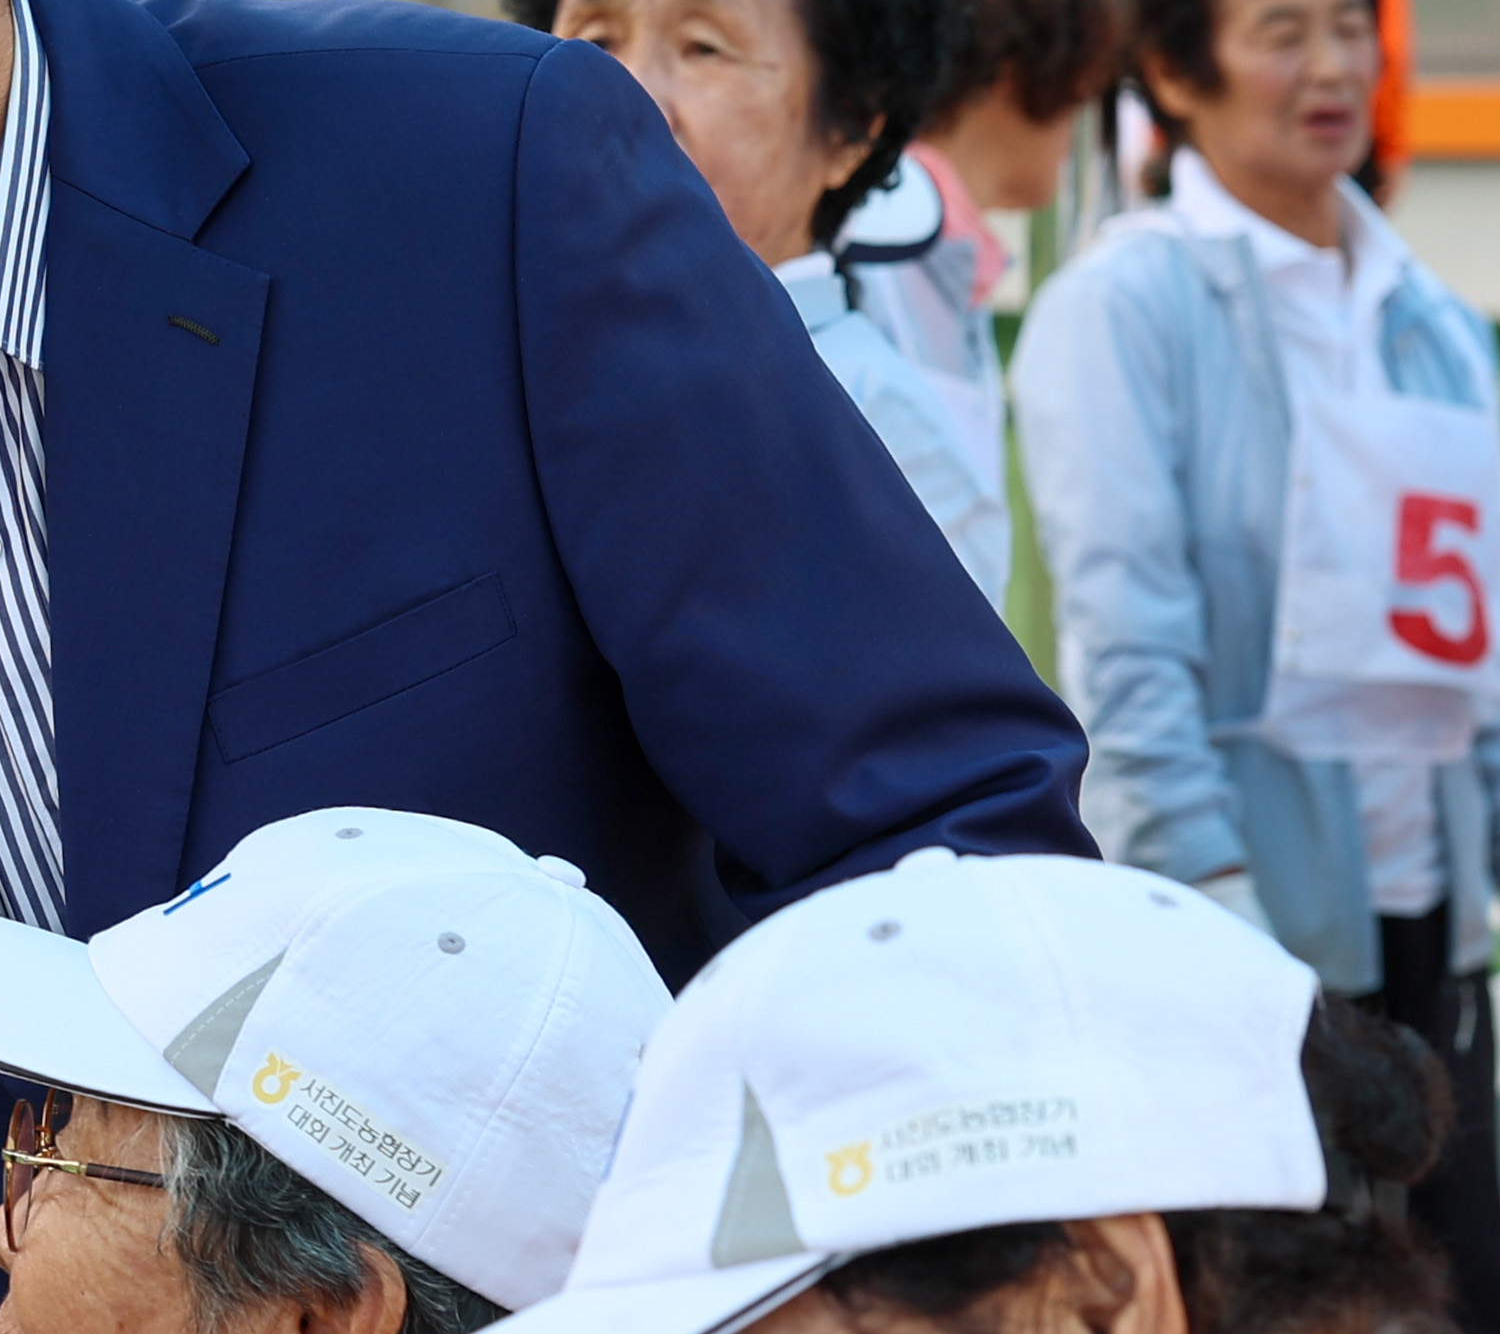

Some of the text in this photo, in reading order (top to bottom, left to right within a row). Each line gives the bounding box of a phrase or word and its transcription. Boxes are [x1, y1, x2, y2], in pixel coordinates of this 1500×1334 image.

[1388, 493, 1490, 666] 5
[287, 1105, 421, 1210] 대회 개최 기념
[300, 1078, 443, 1187] 서진도농협장기
